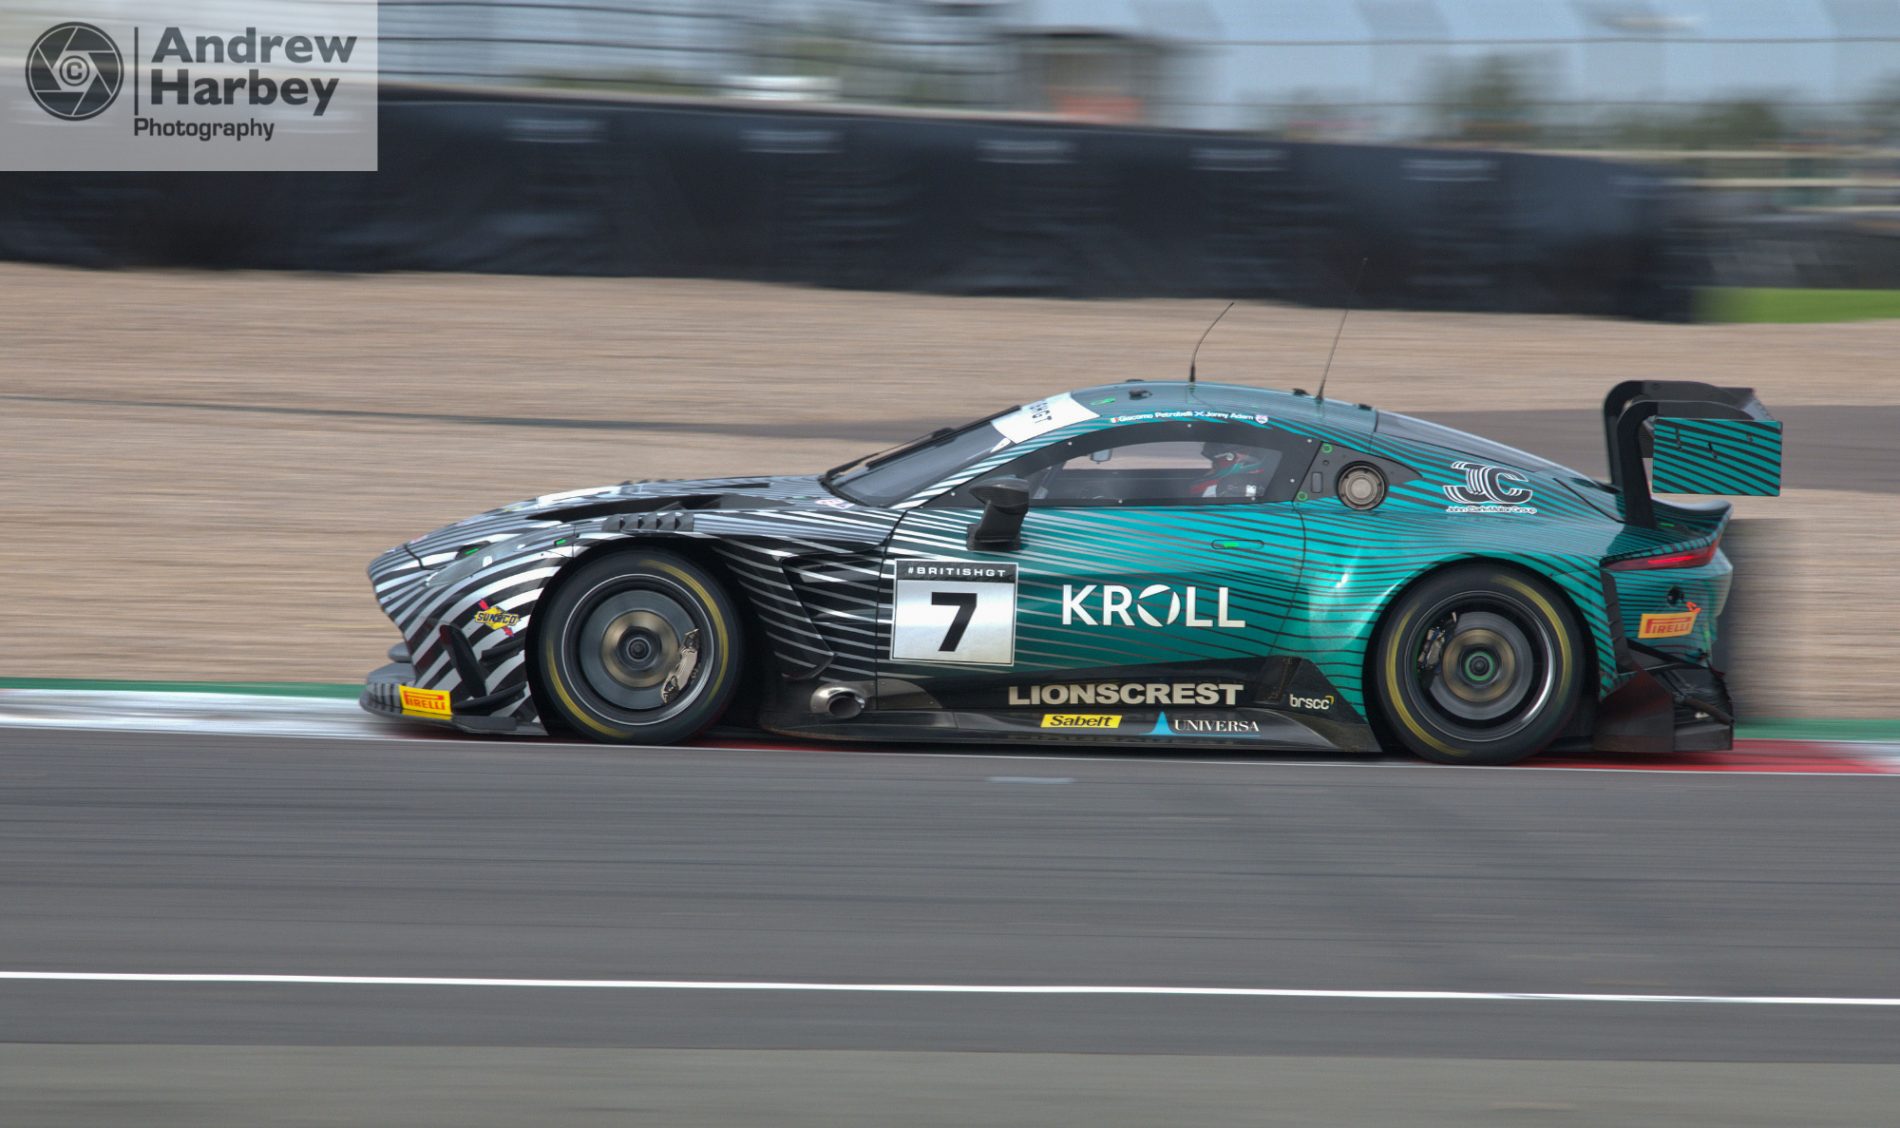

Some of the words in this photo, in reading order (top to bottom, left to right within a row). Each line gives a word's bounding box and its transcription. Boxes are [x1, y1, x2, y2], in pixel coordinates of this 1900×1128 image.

[1443, 461, 1533, 504] JC
[908, 566, 1006, 577] #BRITISHGT
[1062, 584, 1246, 628] KROLL
[931, 592, 978, 652] 7
[1645, 617, 1692, 634] PIRELLI
[403, 691, 446, 710] PIRELLI
[1009, 684, 1244, 705] LIONSCREST
[1290, 693, 1330, 710] brscc
[1049, 715, 1113, 727] Sabelt
[1174, 719, 1260, 732] UNIVERSA
